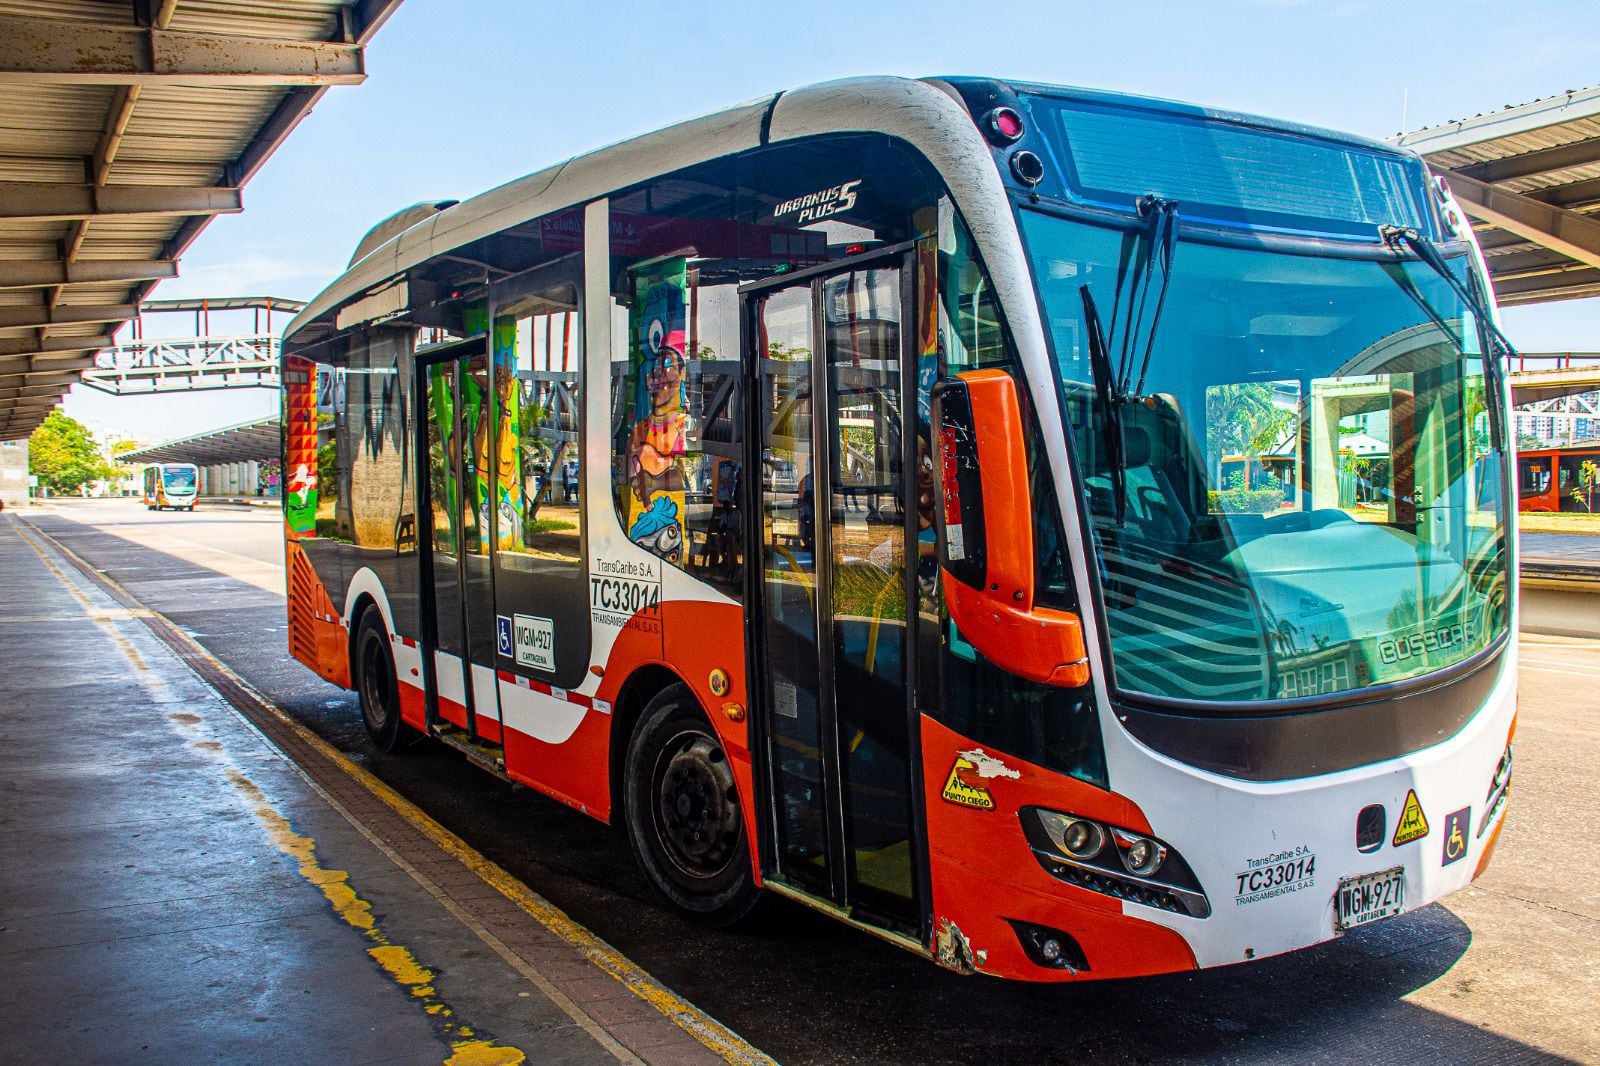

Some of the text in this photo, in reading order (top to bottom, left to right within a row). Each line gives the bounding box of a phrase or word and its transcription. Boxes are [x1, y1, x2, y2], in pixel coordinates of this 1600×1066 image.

[798, 201, 837, 224] PLUS
[597, 558, 654, 577] TransCaribe S.A.
[591, 578, 659, 615] TC33014
[522, 651, 548, 665] CARTAGENA
[944, 791, 990, 806] PUNTO CIEGO
[1246, 844, 1311, 869] TransCaribe S.A.
[1236, 855, 1316, 895] TC33014
[1235, 885, 1297, 906] TRANSAMBIENTAL
[1356, 907, 1387, 924] CARTAGENA
